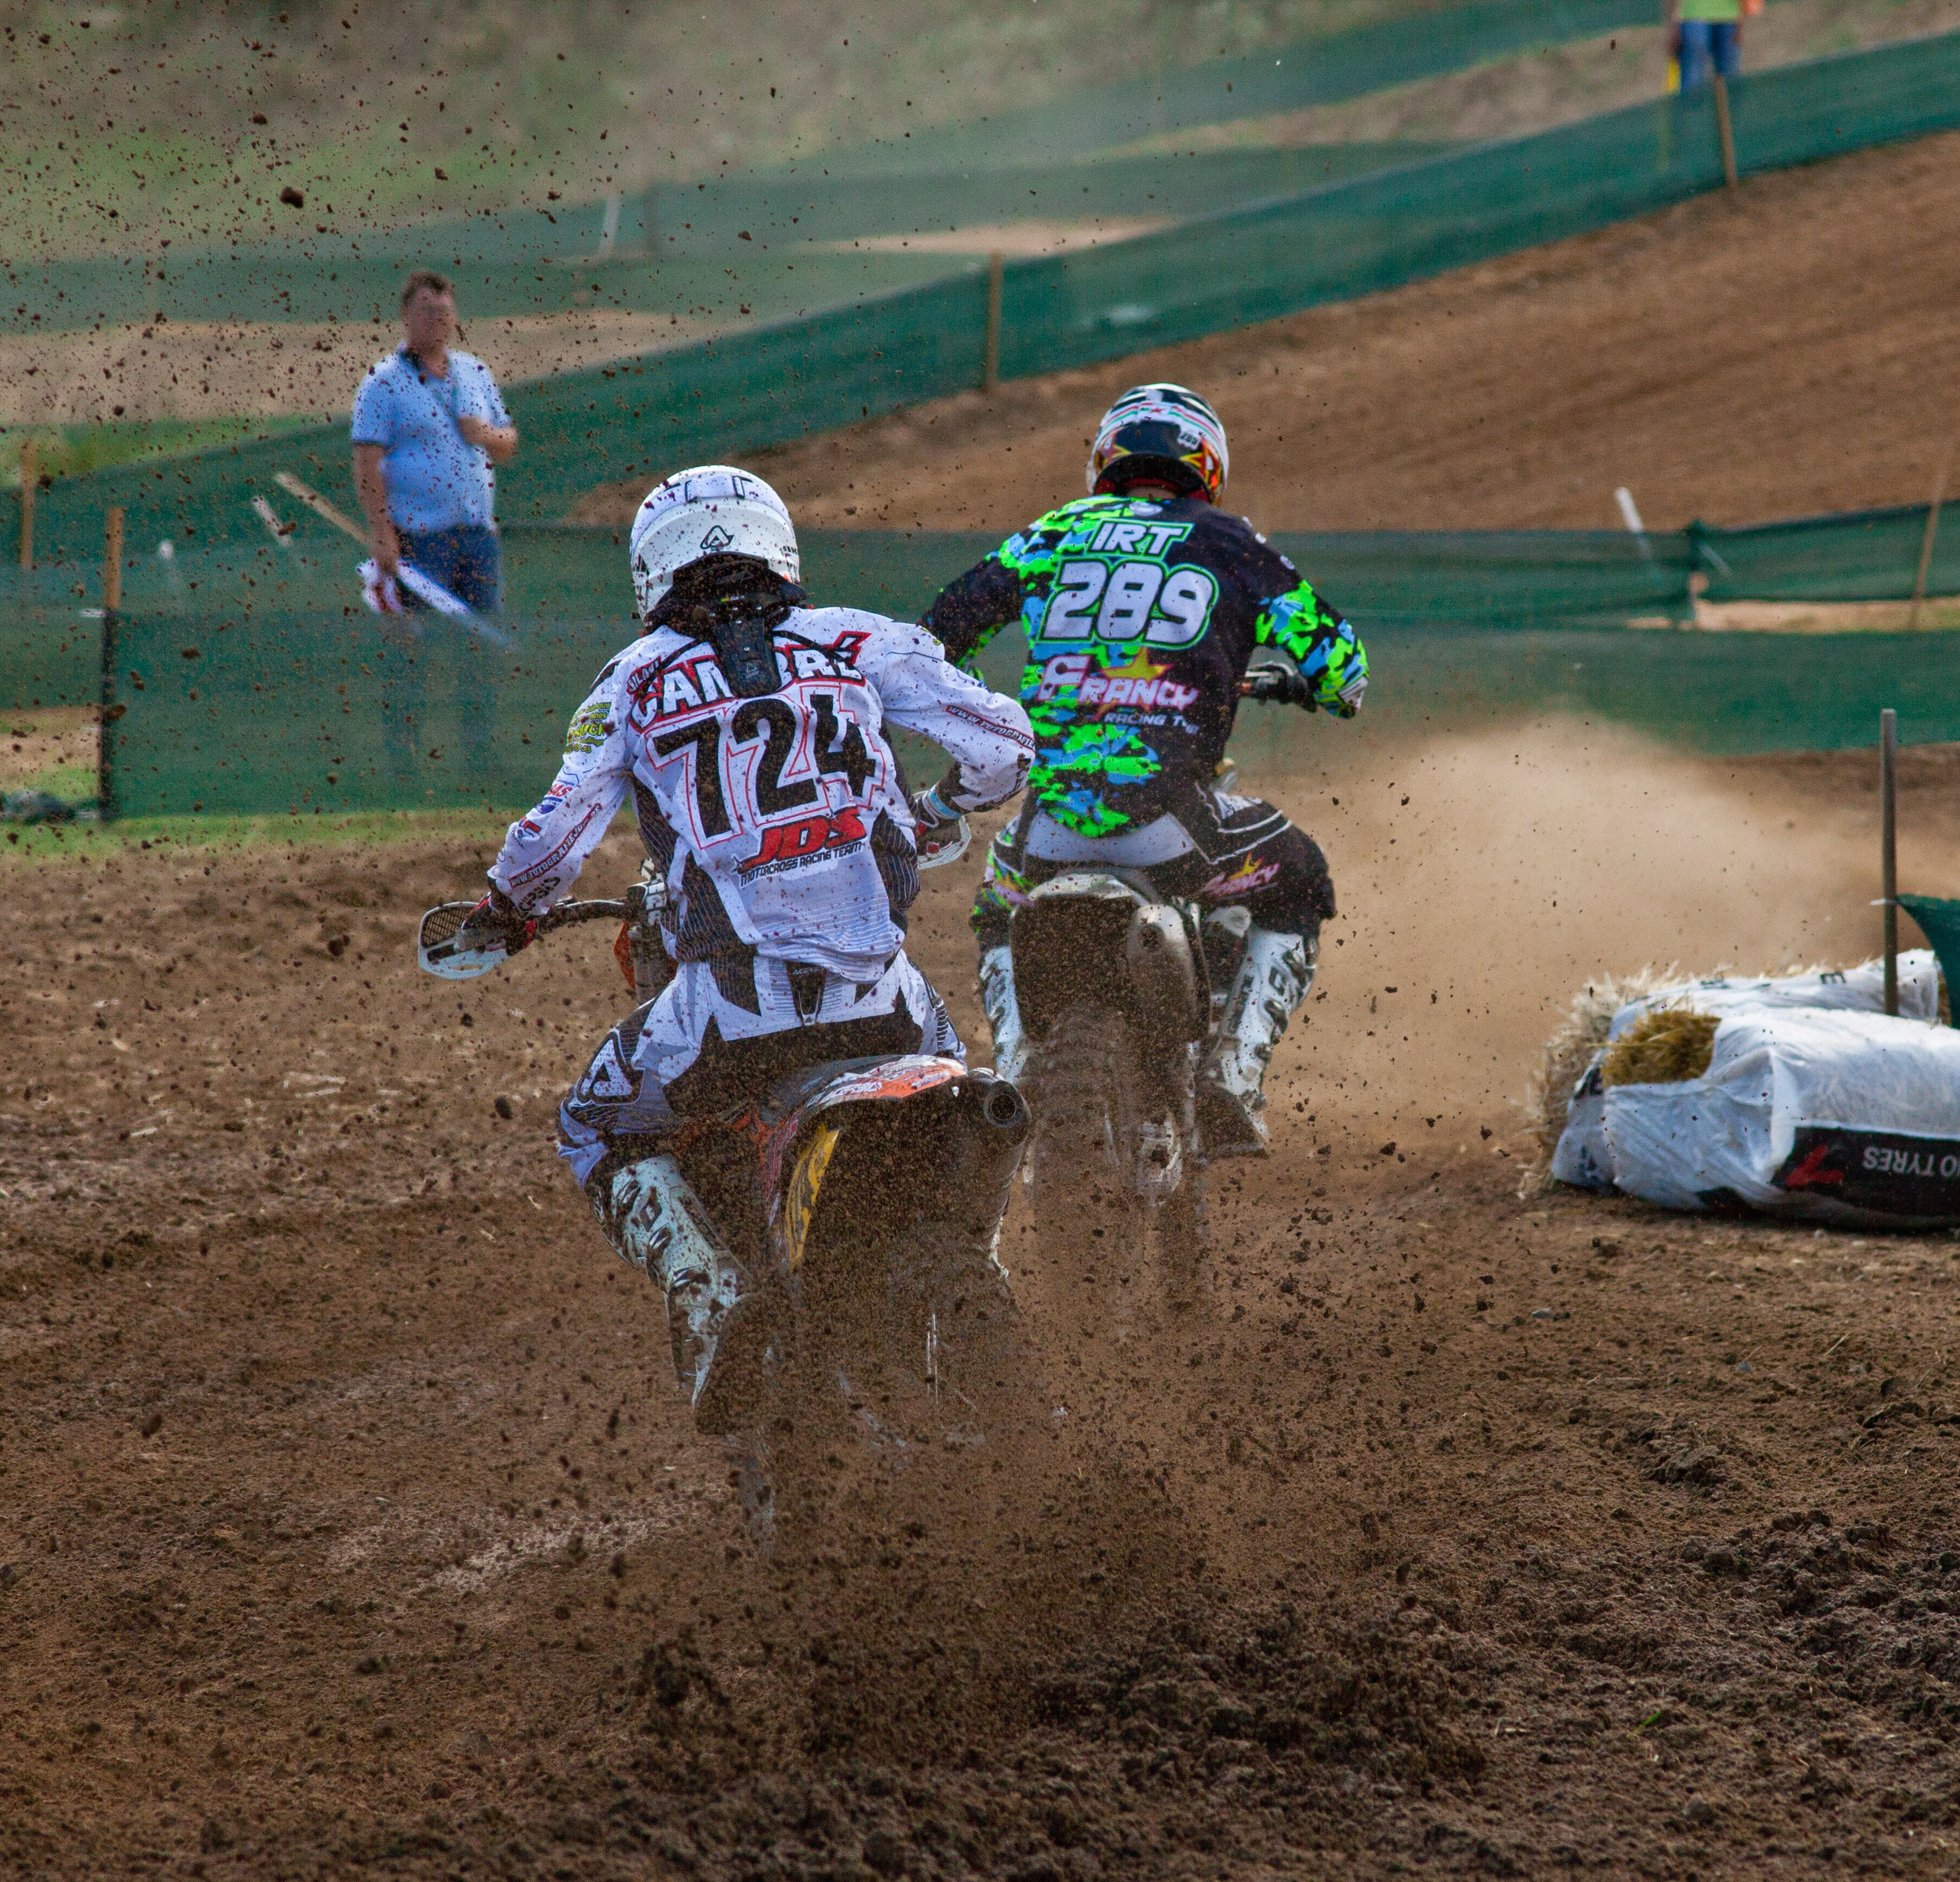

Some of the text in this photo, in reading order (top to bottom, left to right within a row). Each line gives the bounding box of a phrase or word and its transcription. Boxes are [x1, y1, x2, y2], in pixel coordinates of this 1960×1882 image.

[1088, 521, 1187, 556] IRT
[1040, 560, 1216, 645] 289
[1037, 655, 1200, 712] FRANCY
[1103, 711, 1168, 727] RACING
[651, 693, 877, 841] 724
[737, 807, 867, 874] JDS
[799, 849, 832, 867] RACING
[834, 841, 863, 859] TEAM
[1861, 1145, 1936, 1177] TYRES
